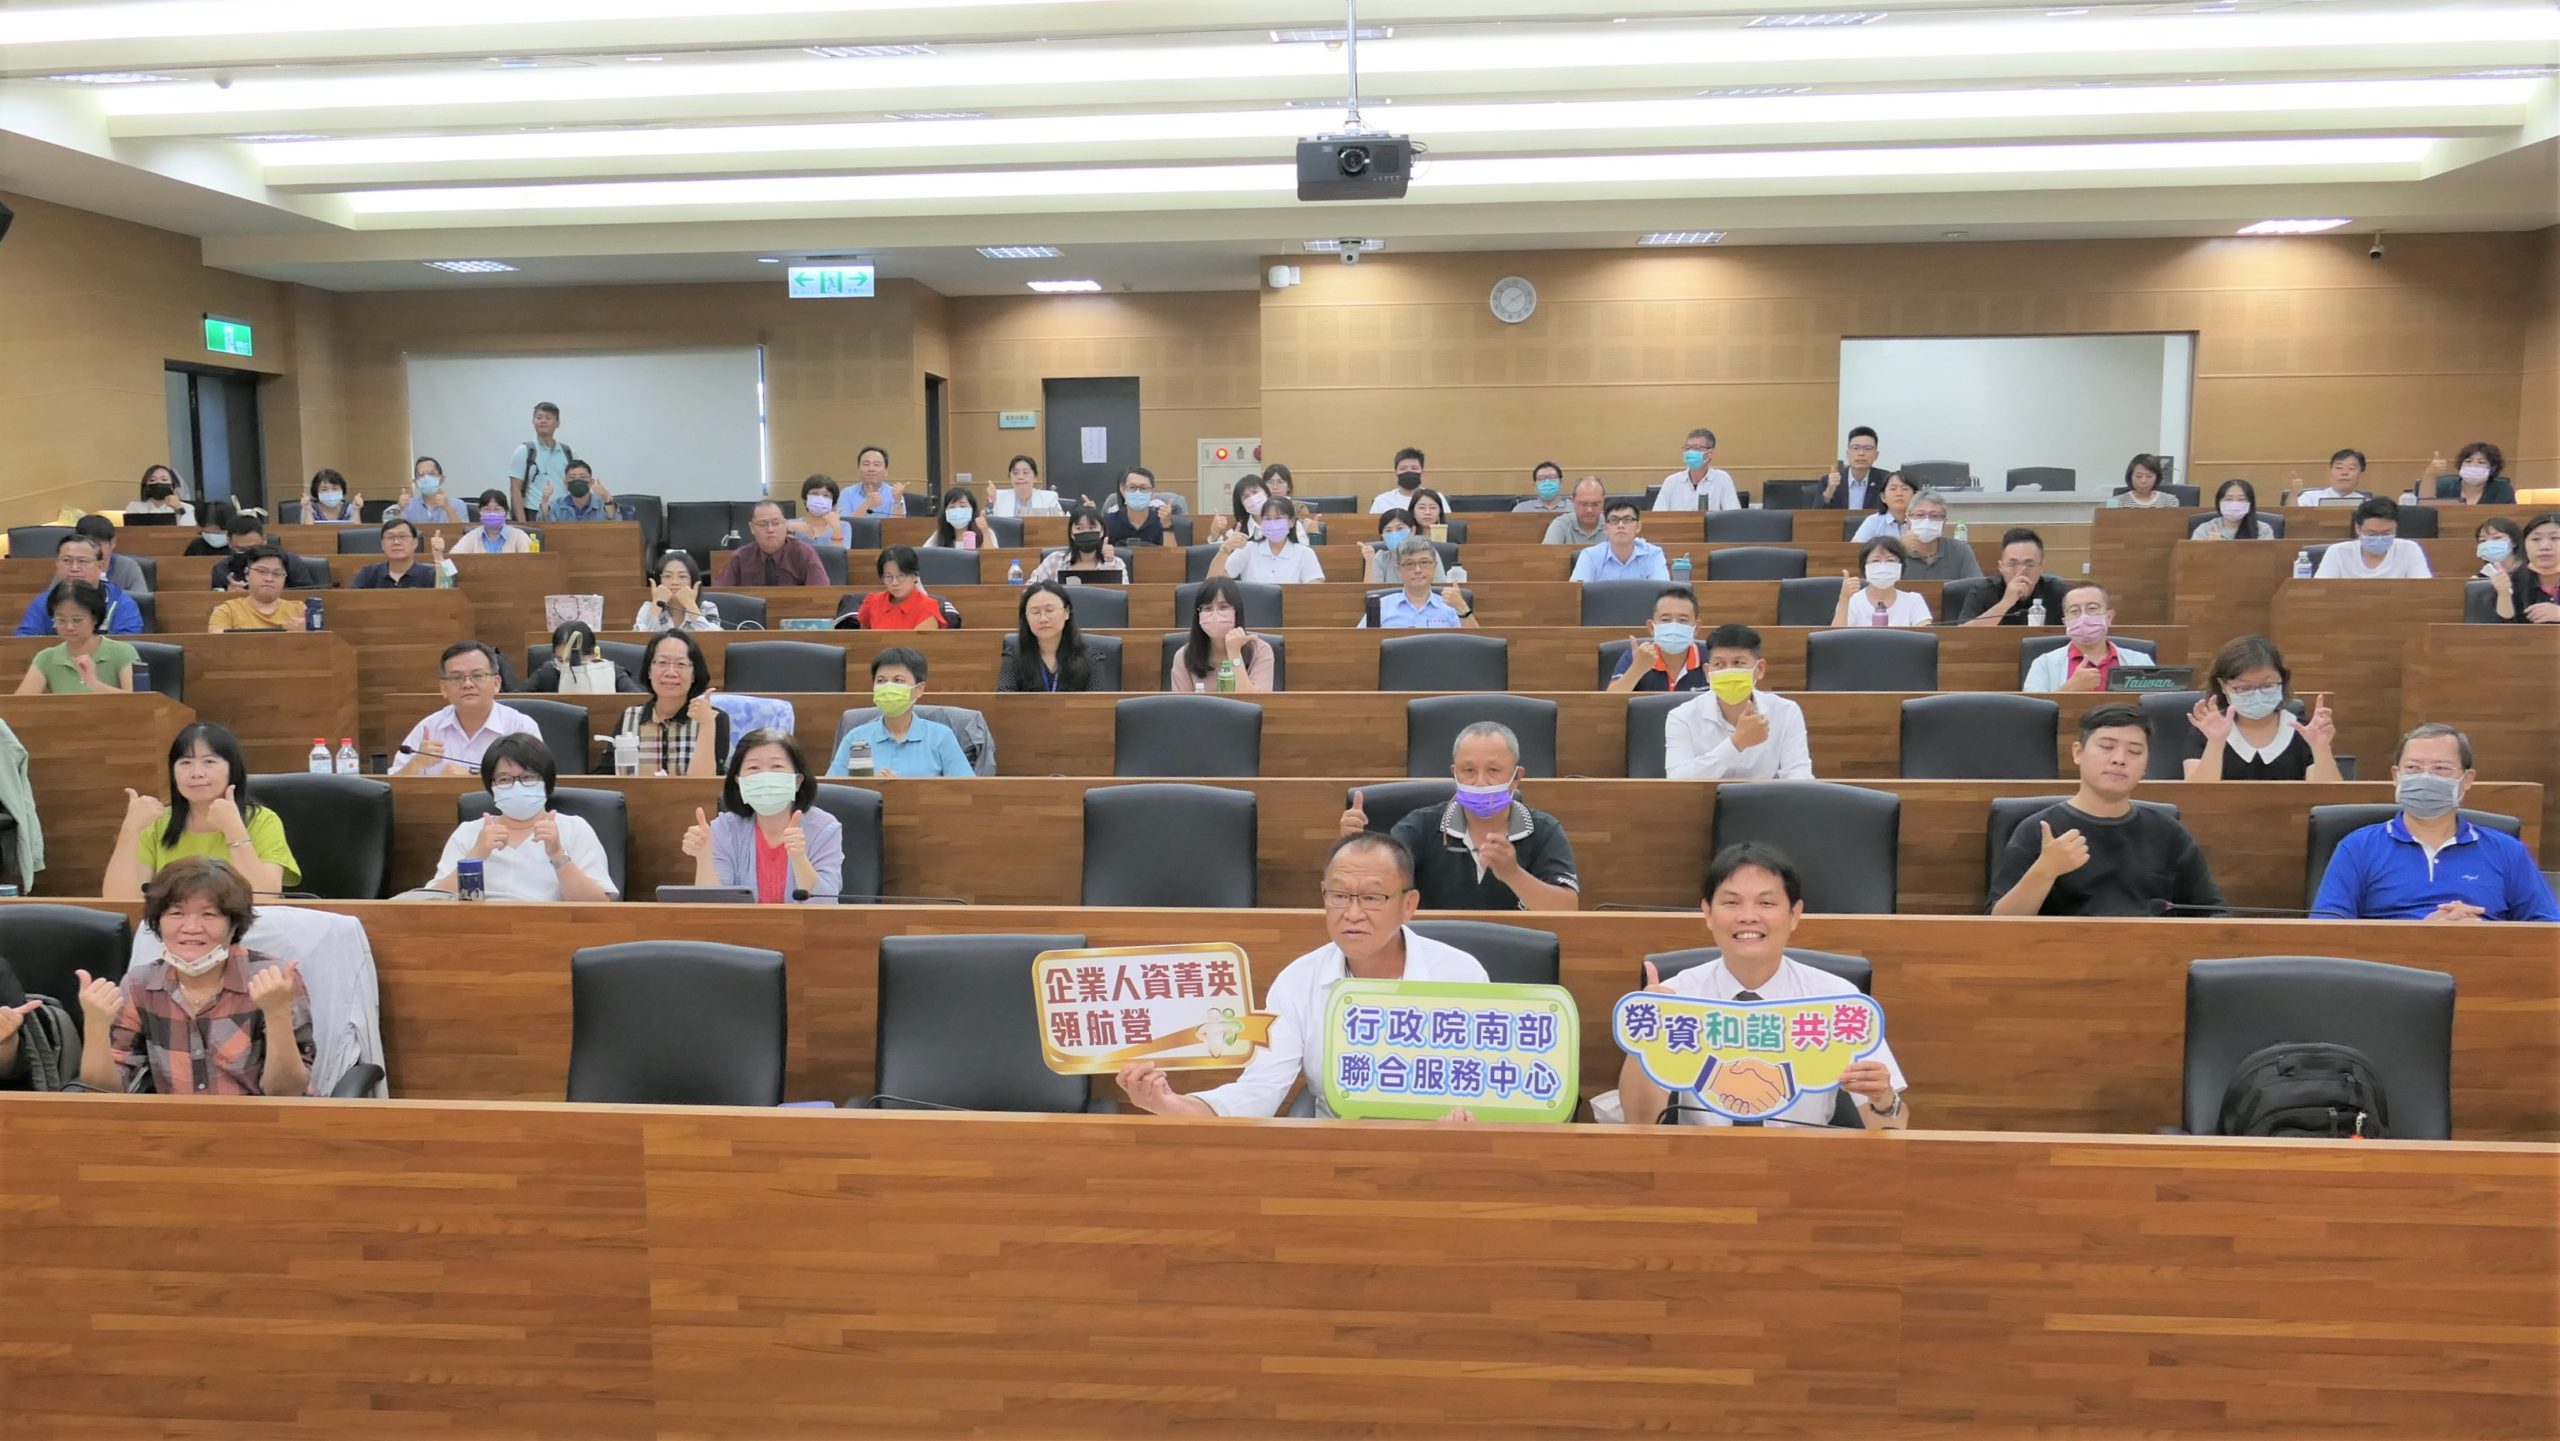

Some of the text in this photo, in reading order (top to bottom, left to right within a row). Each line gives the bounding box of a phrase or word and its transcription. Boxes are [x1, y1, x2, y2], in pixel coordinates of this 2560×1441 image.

[2124, 676, 2174, 688] Taiwan
[1045, 960, 1238, 1004] 企業人資菁英
[1051, 1008, 1153, 1047] 領航營
[1345, 1006, 1553, 1048] 行政院南部
[1624, 1003, 1868, 1050] 勞資和諧共榮
[1340, 1054, 1557, 1094] 聯合服務中心
